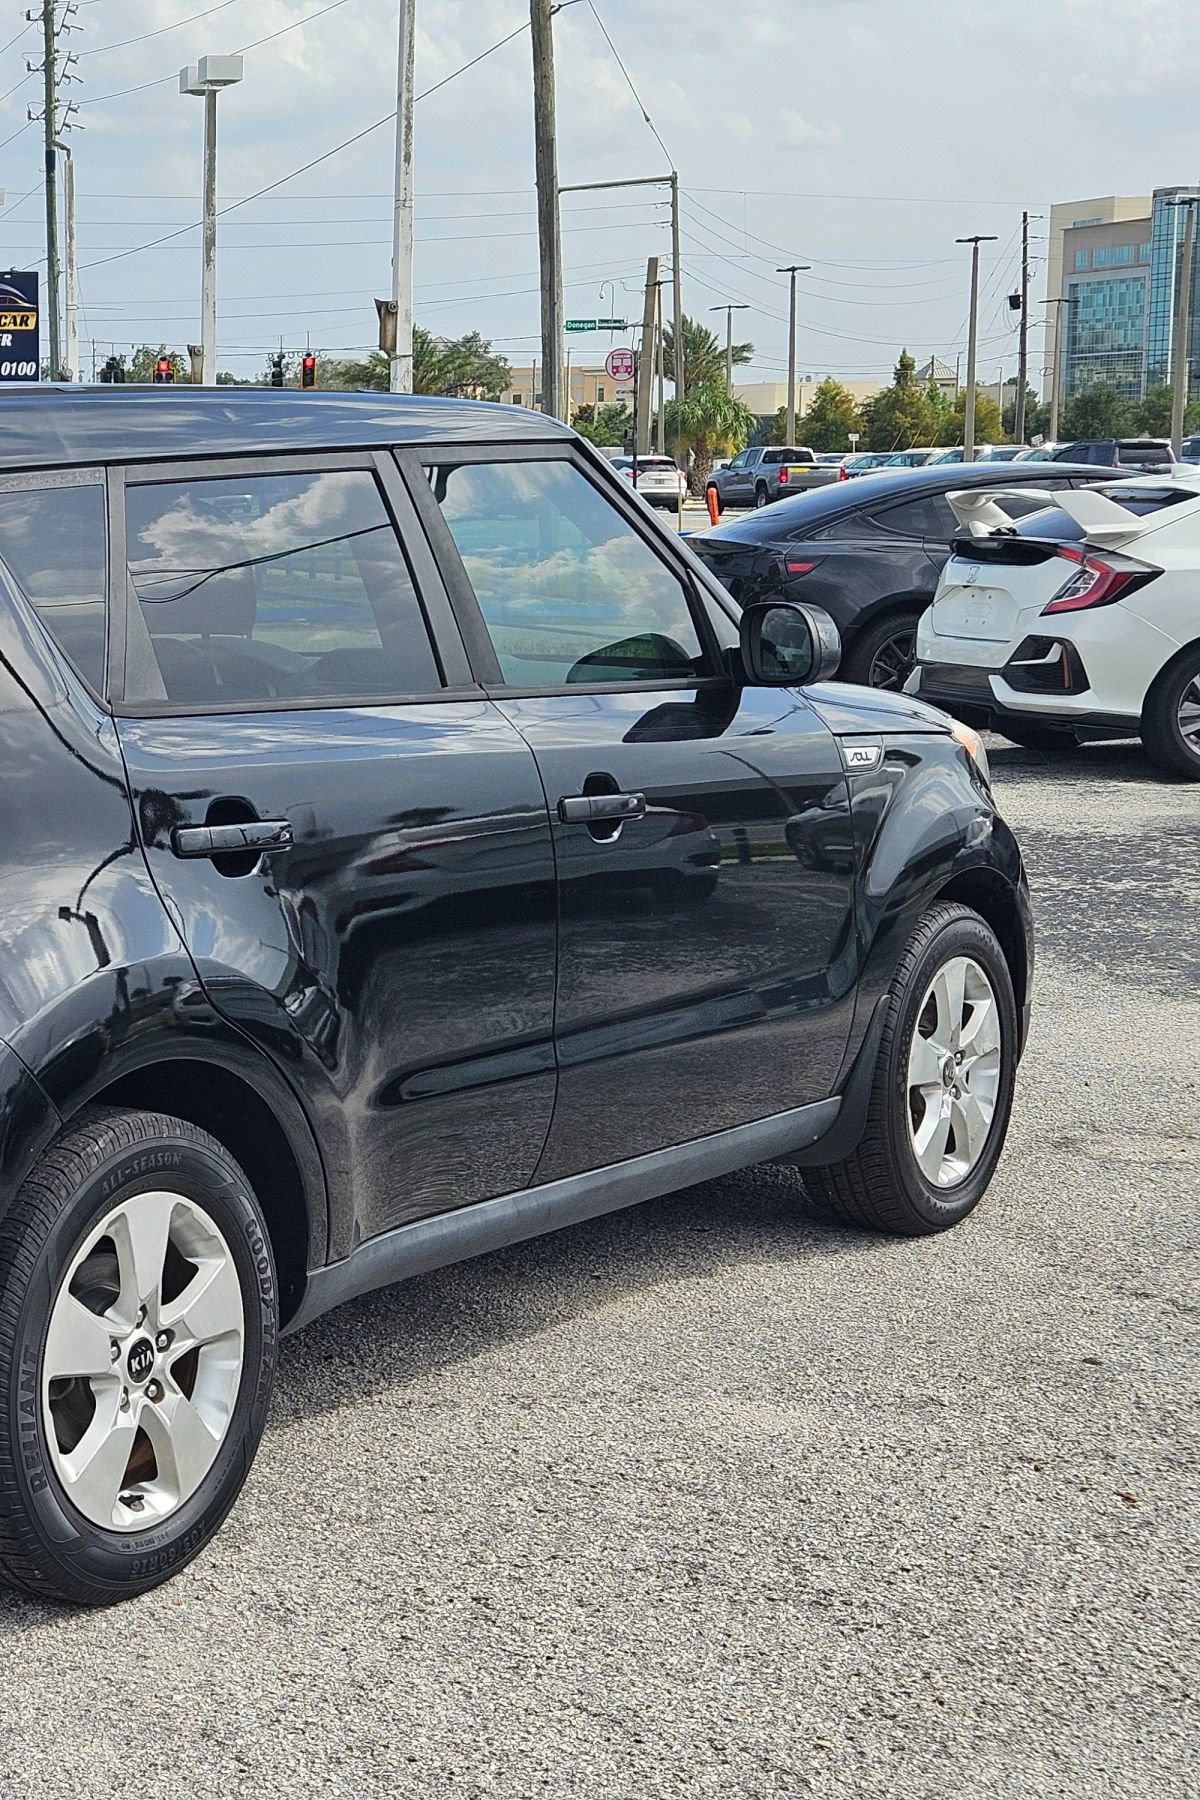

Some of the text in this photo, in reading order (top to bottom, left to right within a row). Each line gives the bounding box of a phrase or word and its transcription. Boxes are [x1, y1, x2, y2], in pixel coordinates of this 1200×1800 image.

[567, 321, 596, 330] Donegan
[1, 361, 36, 376] 0100
[102, 1152, 182, 1197] ALL-SEASON
[131, 1350, 153, 1373] KIA
[20, 1343, 48, 1494] RELIANT
